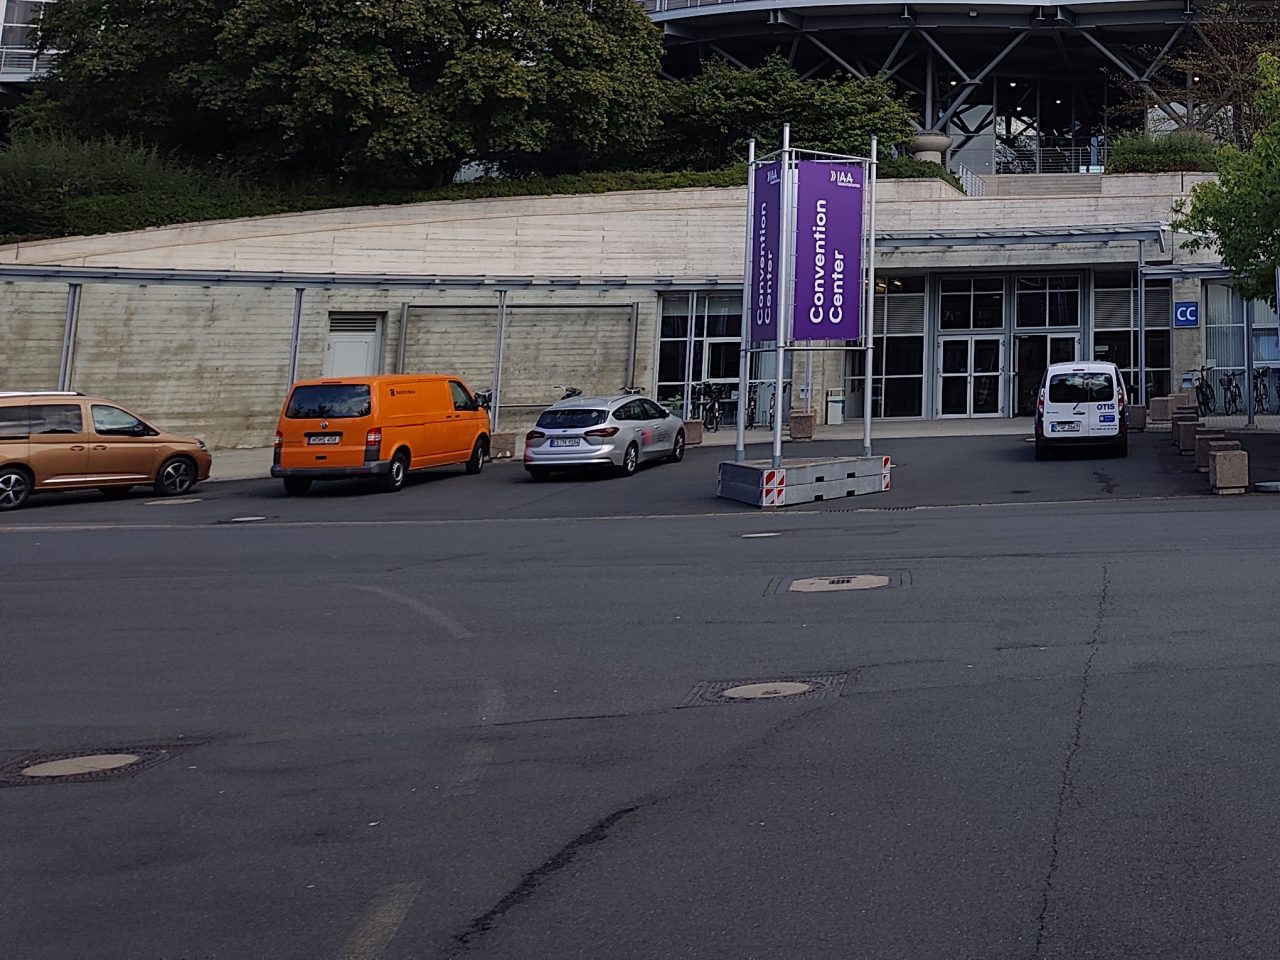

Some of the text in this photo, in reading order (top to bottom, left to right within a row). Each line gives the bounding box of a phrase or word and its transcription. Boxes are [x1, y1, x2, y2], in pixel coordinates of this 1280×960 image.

[837, 171, 853, 183] IAA
[757, 202, 767, 326] Convention
[764, 251, 772, 325] Center
[810, 199, 827, 324] Convention
[829, 250, 844, 324] Center
[1177, 307, 1196, 321] CC
